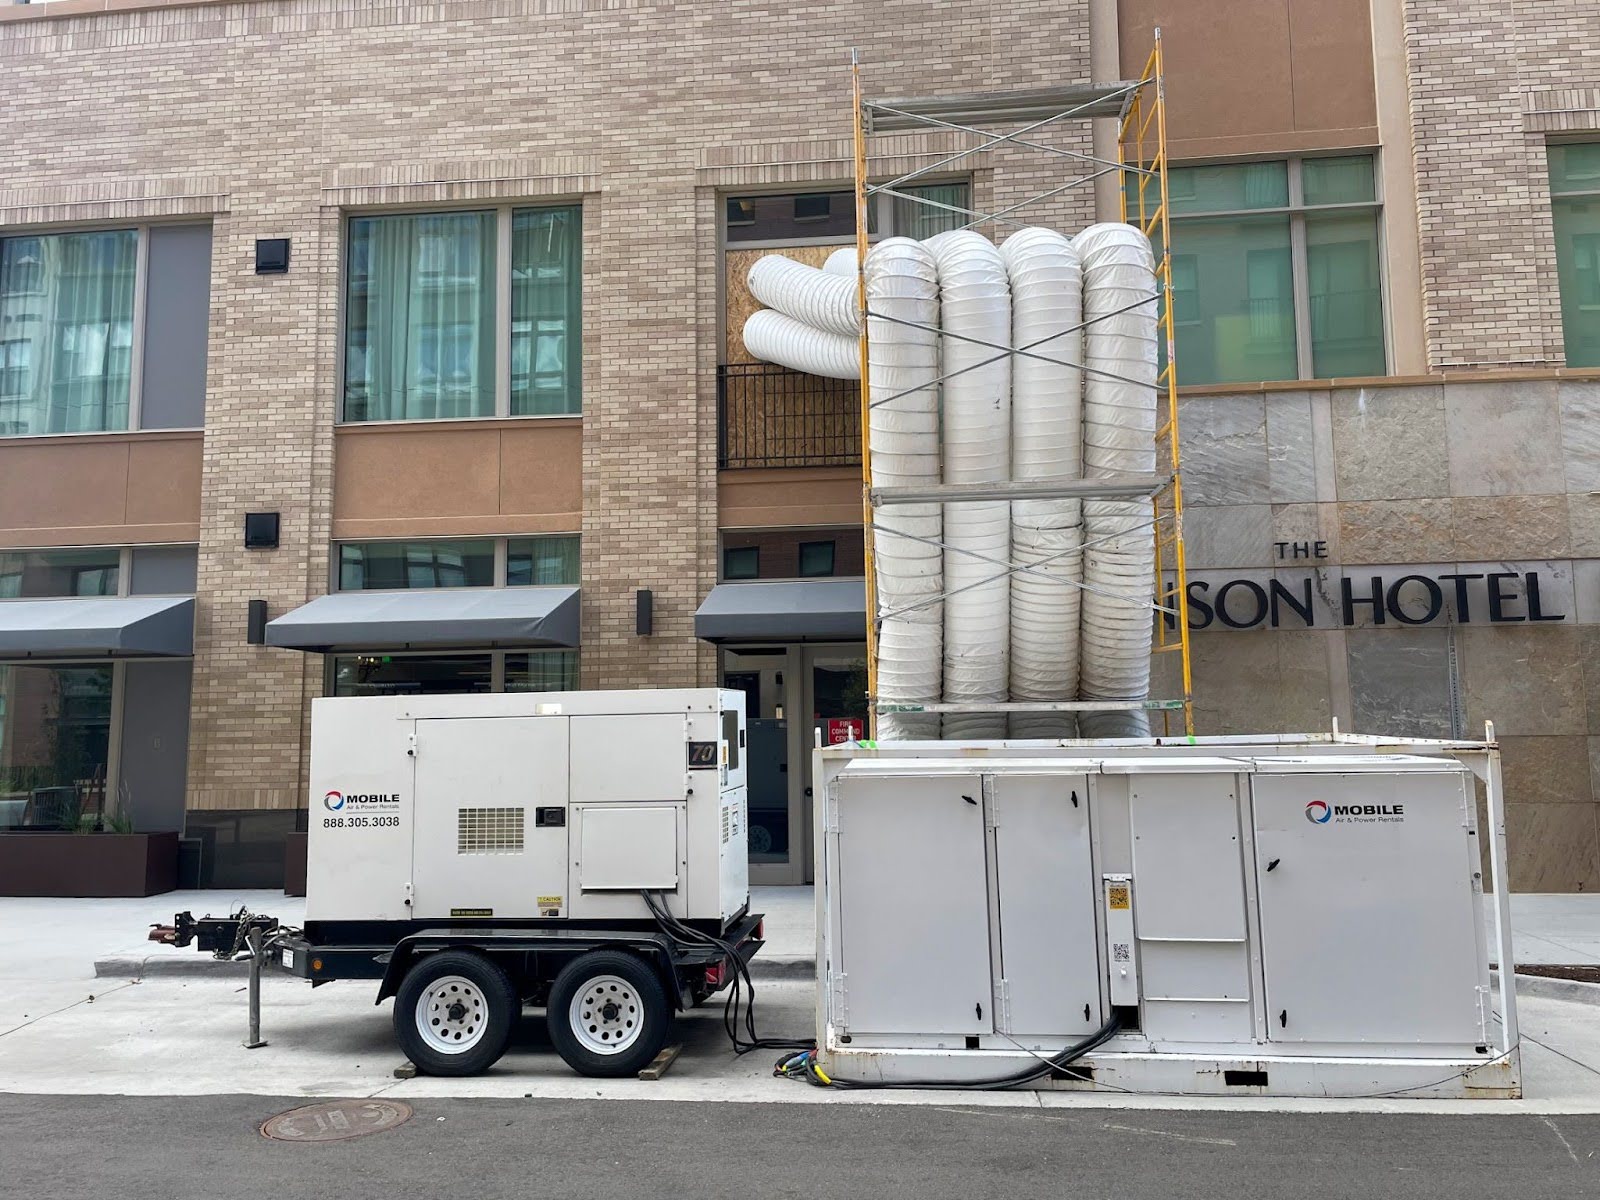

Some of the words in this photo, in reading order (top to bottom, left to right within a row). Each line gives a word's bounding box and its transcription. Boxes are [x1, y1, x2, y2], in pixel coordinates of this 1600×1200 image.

[1273, 541, 1328, 559] THE
[1340, 572, 1566, 626] HOTEL
[692, 745, 715, 762] 70
[346, 794, 400, 804] MOBILE
[1334, 805, 1404, 815] MOBILE
[323, 816, 400, 828] 888.305.3038
